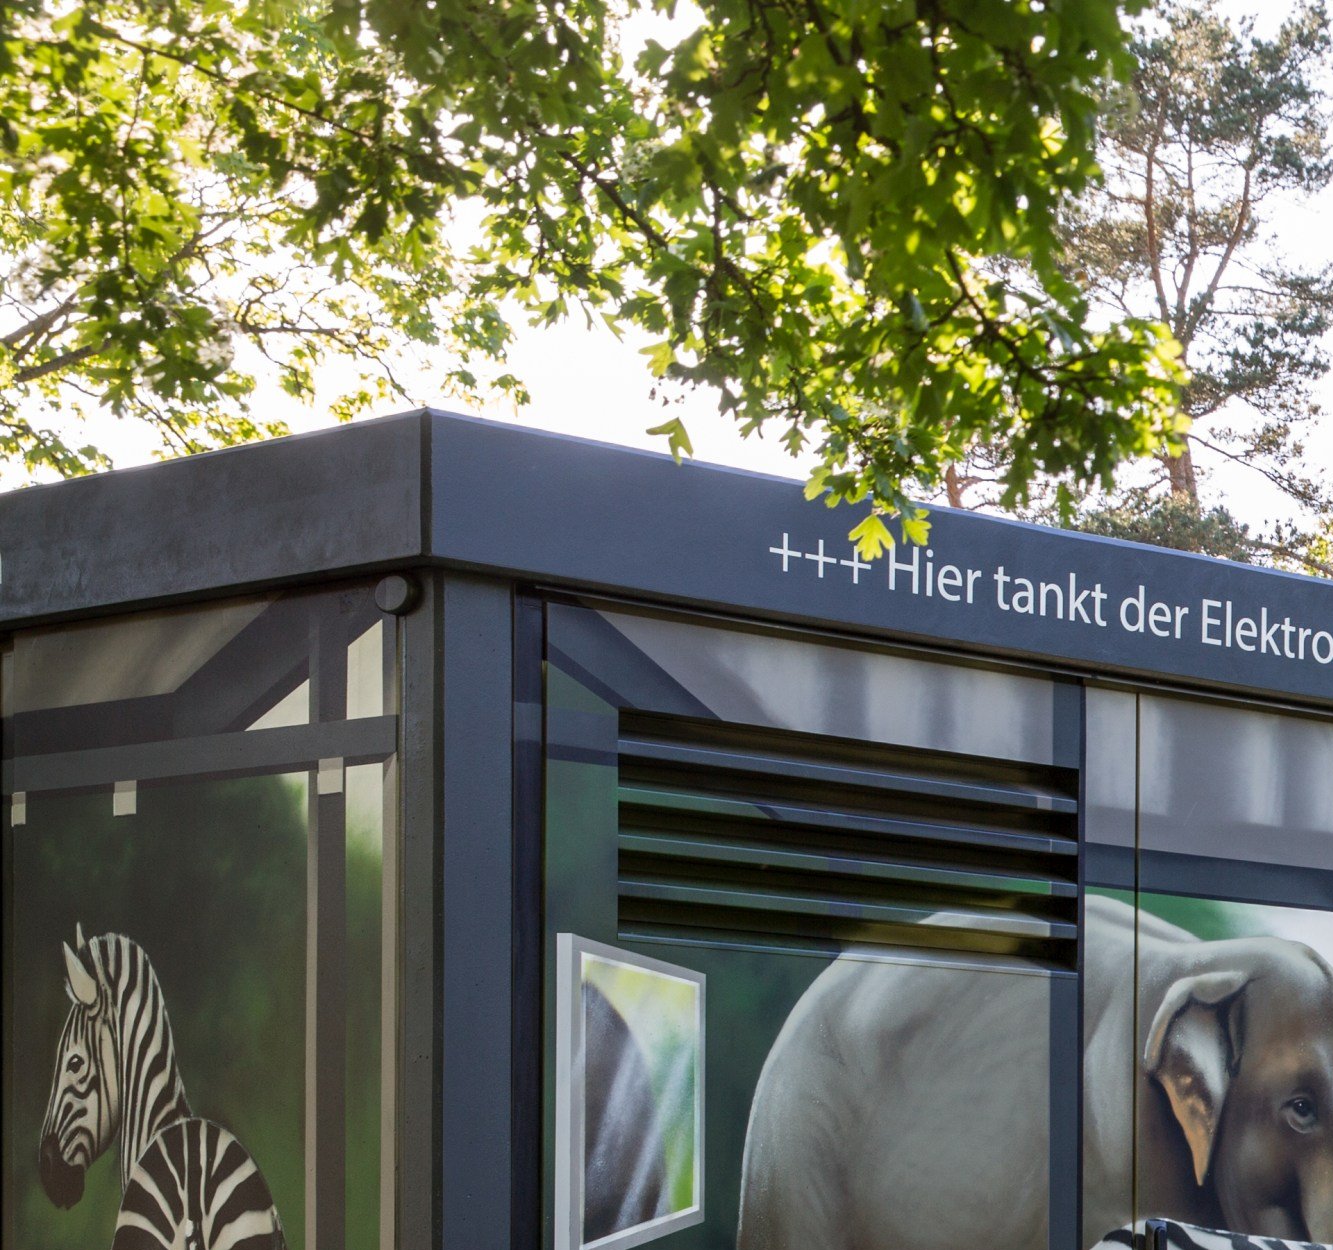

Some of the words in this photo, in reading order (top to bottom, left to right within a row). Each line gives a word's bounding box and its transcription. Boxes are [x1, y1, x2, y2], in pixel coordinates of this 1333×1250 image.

[888, 542, 982, 604] Hier
[993, 565, 1108, 628] tankt
[1119, 584, 1189, 640] der
